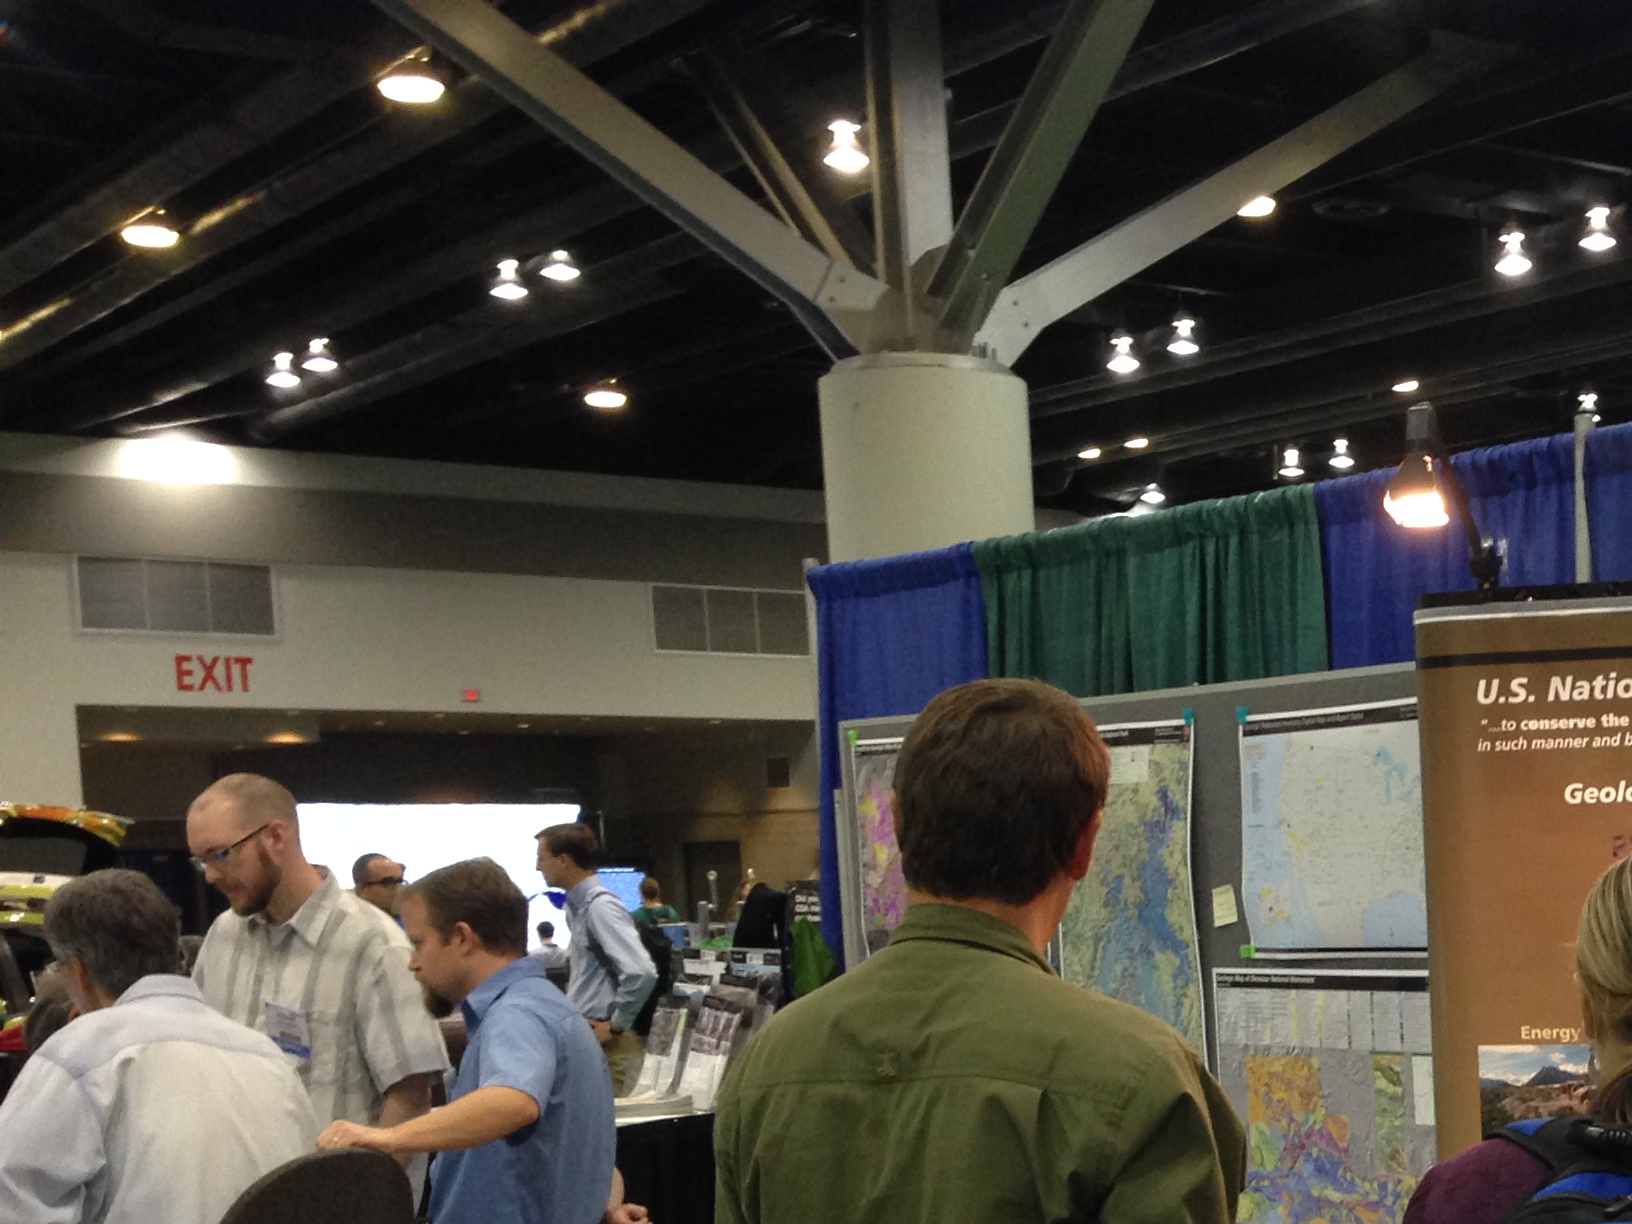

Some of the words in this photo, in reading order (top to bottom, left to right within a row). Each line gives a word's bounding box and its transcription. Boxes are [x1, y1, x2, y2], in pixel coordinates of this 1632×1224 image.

[175, 654, 253, 693] EXIT
[1476, 677, 1536, 705] U.S.
[1520, 714, 1596, 731] conserve
[1600, 712, 1631, 728] the
[1477, 738, 1491, 752] in
[1495, 734, 1528, 751] such
[1531, 734, 1589, 749] manner
[1592, 732, 1620, 748] and
[1521, 1025, 1580, 1043] Energy
